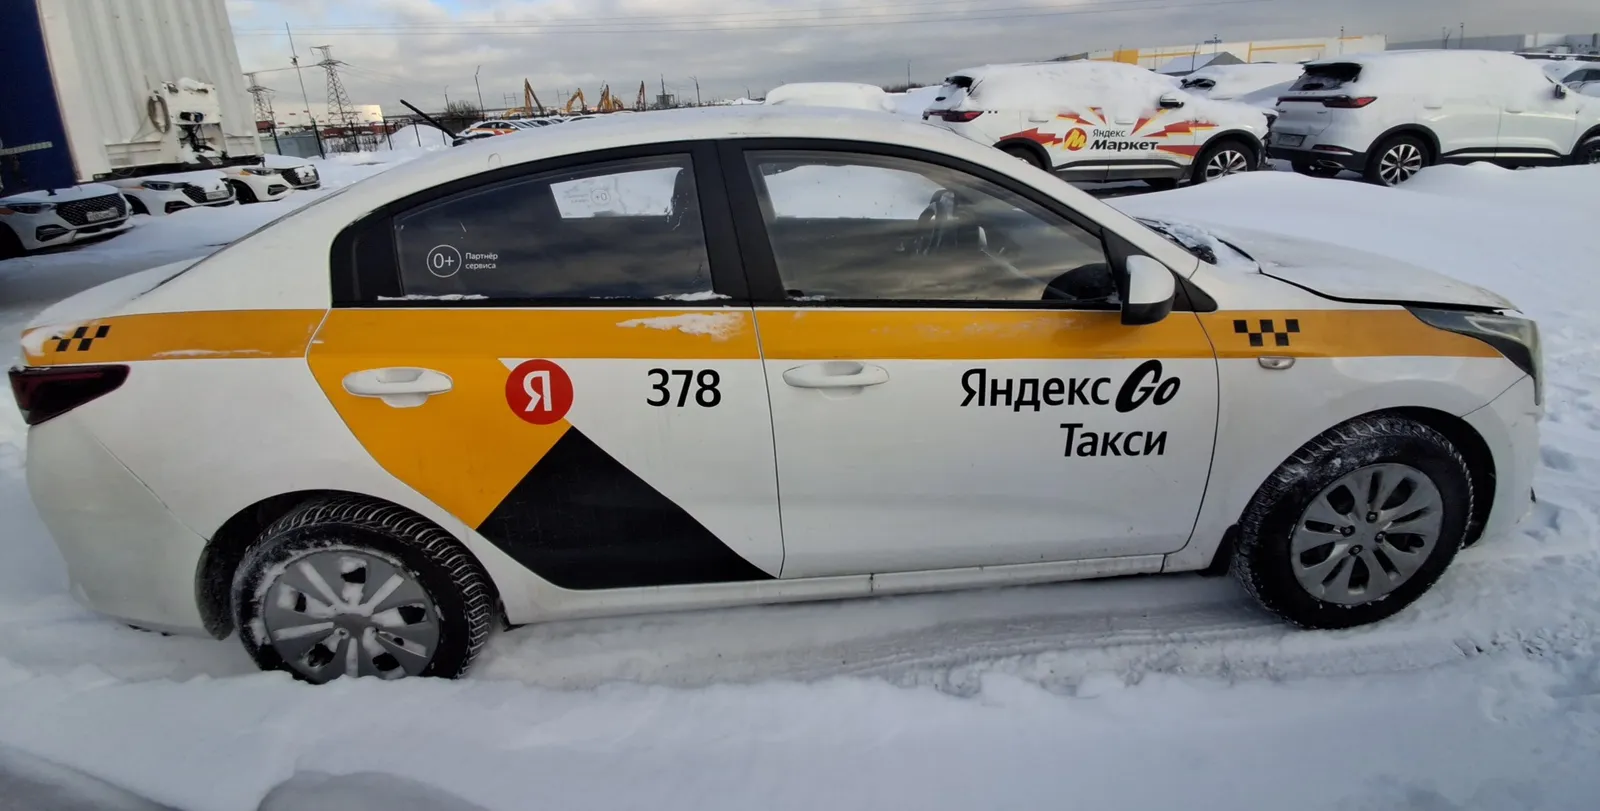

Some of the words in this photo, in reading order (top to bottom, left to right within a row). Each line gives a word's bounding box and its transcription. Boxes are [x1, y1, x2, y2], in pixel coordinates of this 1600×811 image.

[1090, 140, 1158, 152] Маркет
[1092, 129, 1126, 138] Яндекс
[433, 253, 455, 269] 0+
[465, 252, 498, 260] Партнёр
[523, 370, 552, 412] Я
[646, 368, 722, 408] 378
[960, 368, 1111, 412] Яндекс
[1115, 359, 1181, 413] Go
[1060, 423, 1168, 457] Такси
